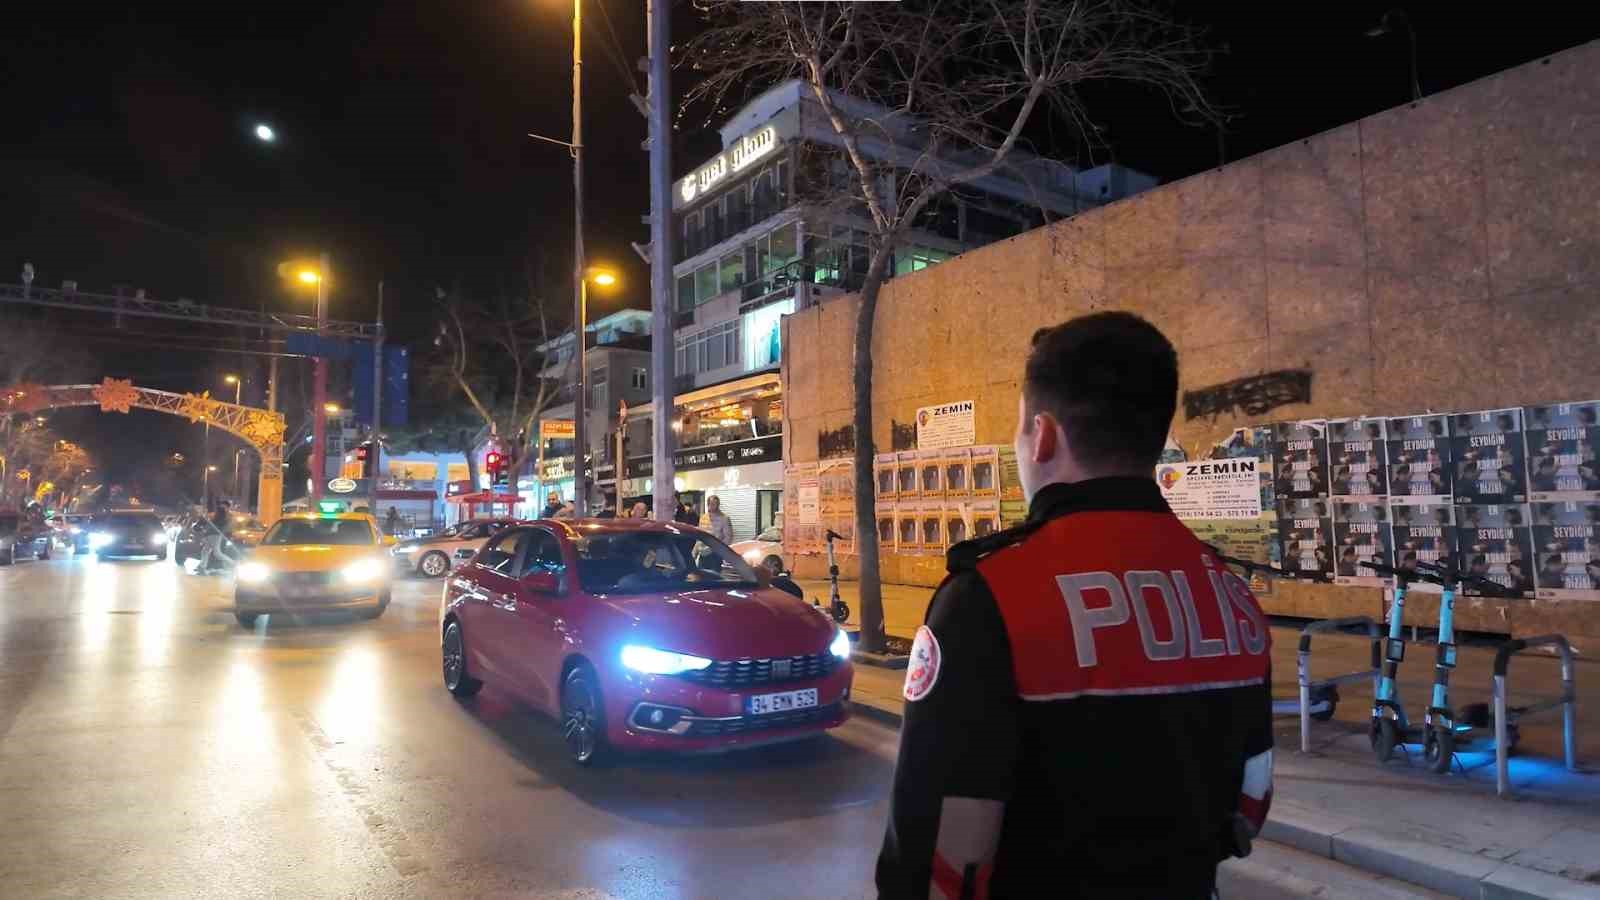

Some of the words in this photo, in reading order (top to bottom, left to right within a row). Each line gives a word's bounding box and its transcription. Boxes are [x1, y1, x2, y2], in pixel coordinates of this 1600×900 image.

[1186, 460, 1255, 476] ZEMİN
[1055, 554, 1266, 668] POLİS
[753, 697, 768, 713] 34
